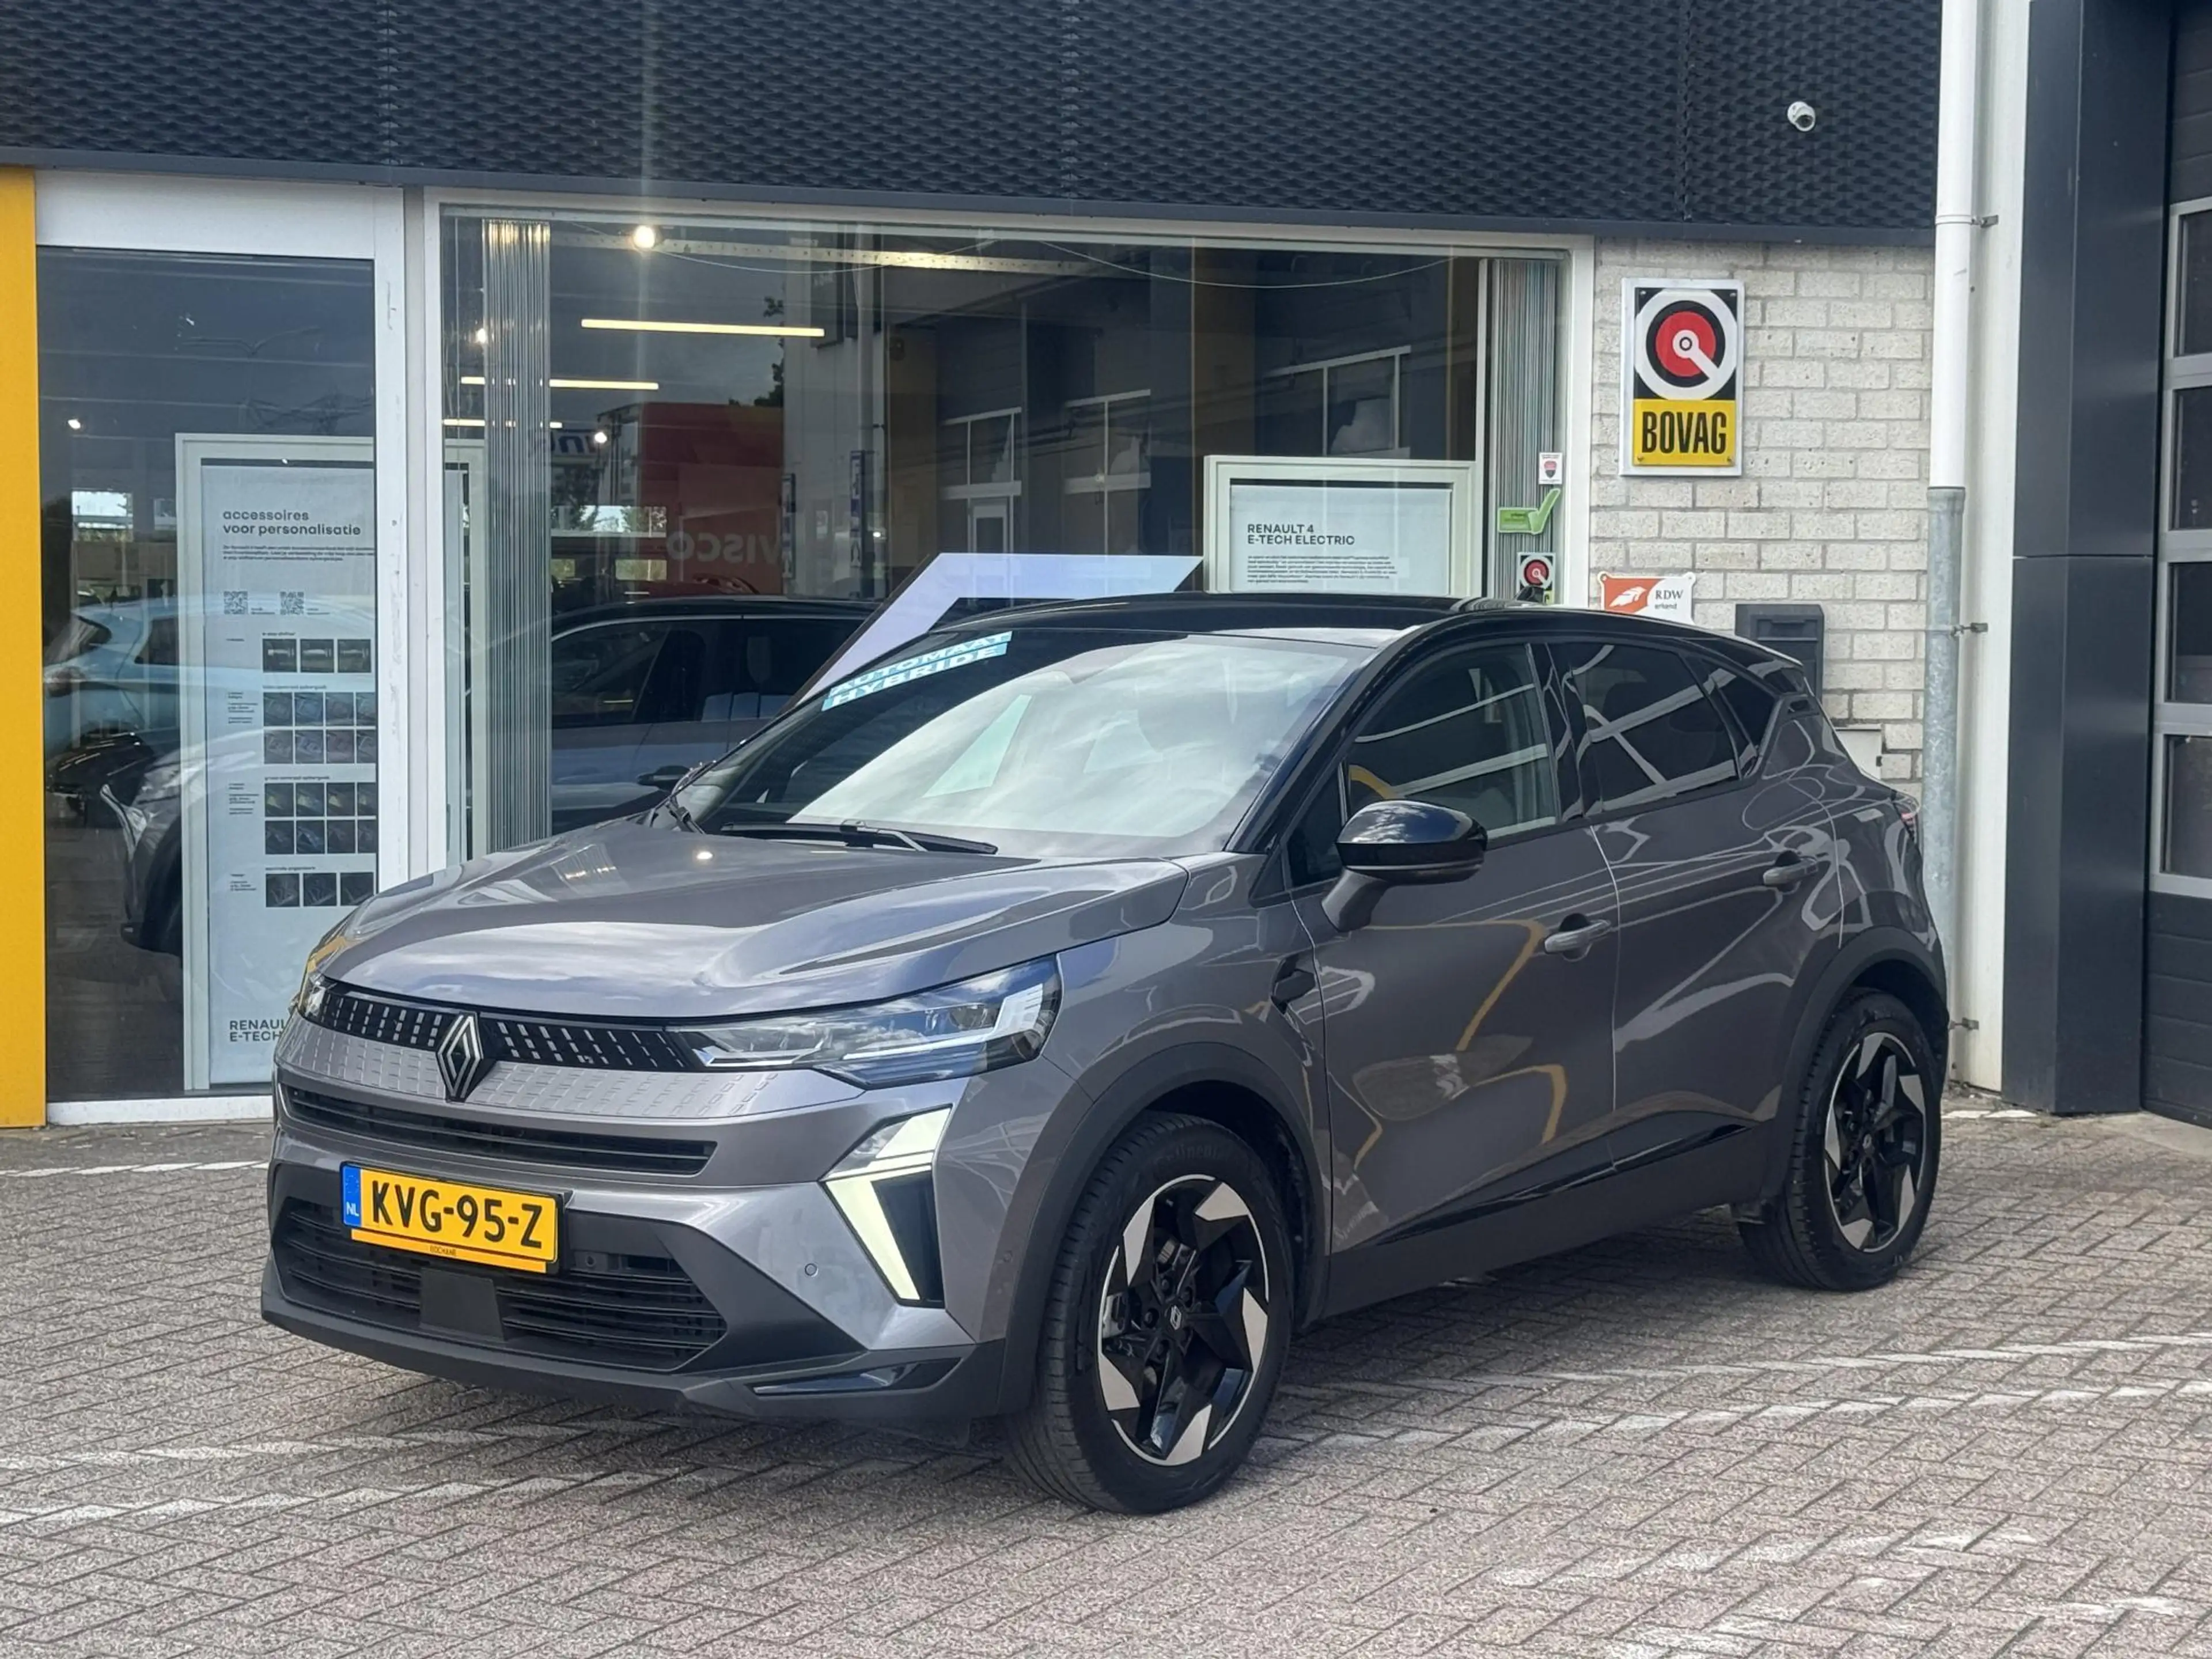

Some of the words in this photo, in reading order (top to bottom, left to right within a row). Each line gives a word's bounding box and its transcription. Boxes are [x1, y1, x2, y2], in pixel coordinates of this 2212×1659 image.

[1642, 411, 1726, 454] BOVAG
[223, 510, 309, 521] accessoires
[223, 525, 255, 535] voor
[259, 524, 361, 536] personalisatie
[1248, 524, 1304, 533] RENAULT
[1306, 524, 1314, 533] 4
[1248, 535, 1292, 545] E-TECH
[1296, 535, 1355, 546] ELECTRIC
[1656, 589, 1683, 600] RDW
[830, 632, 1011, 695] AUTOMAAT
[833, 646, 998, 705] HYBRIDE
[346, 1202, 359, 1217] NL
[372, 1180, 543, 1249] KVG-95-Z
